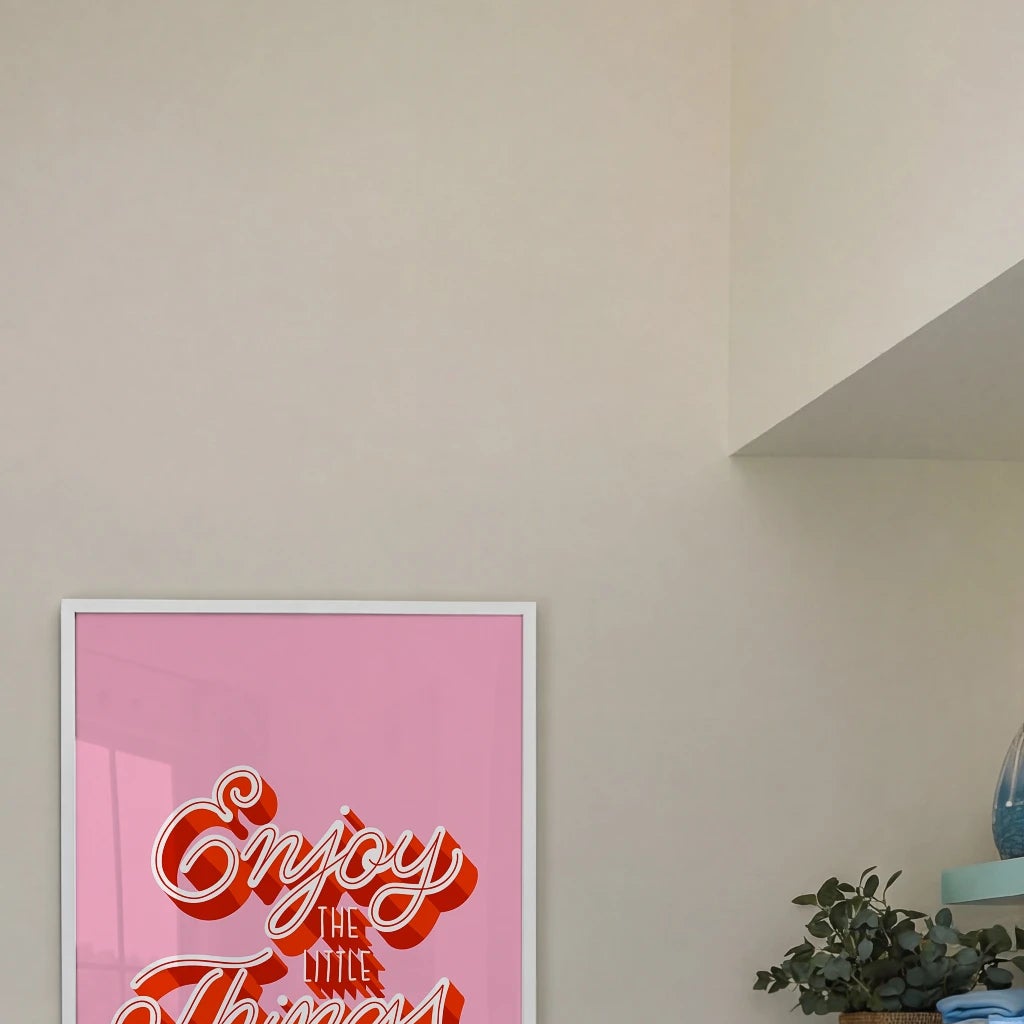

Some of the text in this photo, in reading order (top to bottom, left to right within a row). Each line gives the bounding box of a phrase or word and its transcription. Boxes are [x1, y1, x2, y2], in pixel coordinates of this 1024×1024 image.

[151, 765, 474, 946] Enjoy
[317, 905, 361, 939] THE
[302, 949, 373, 983] LITTLE
